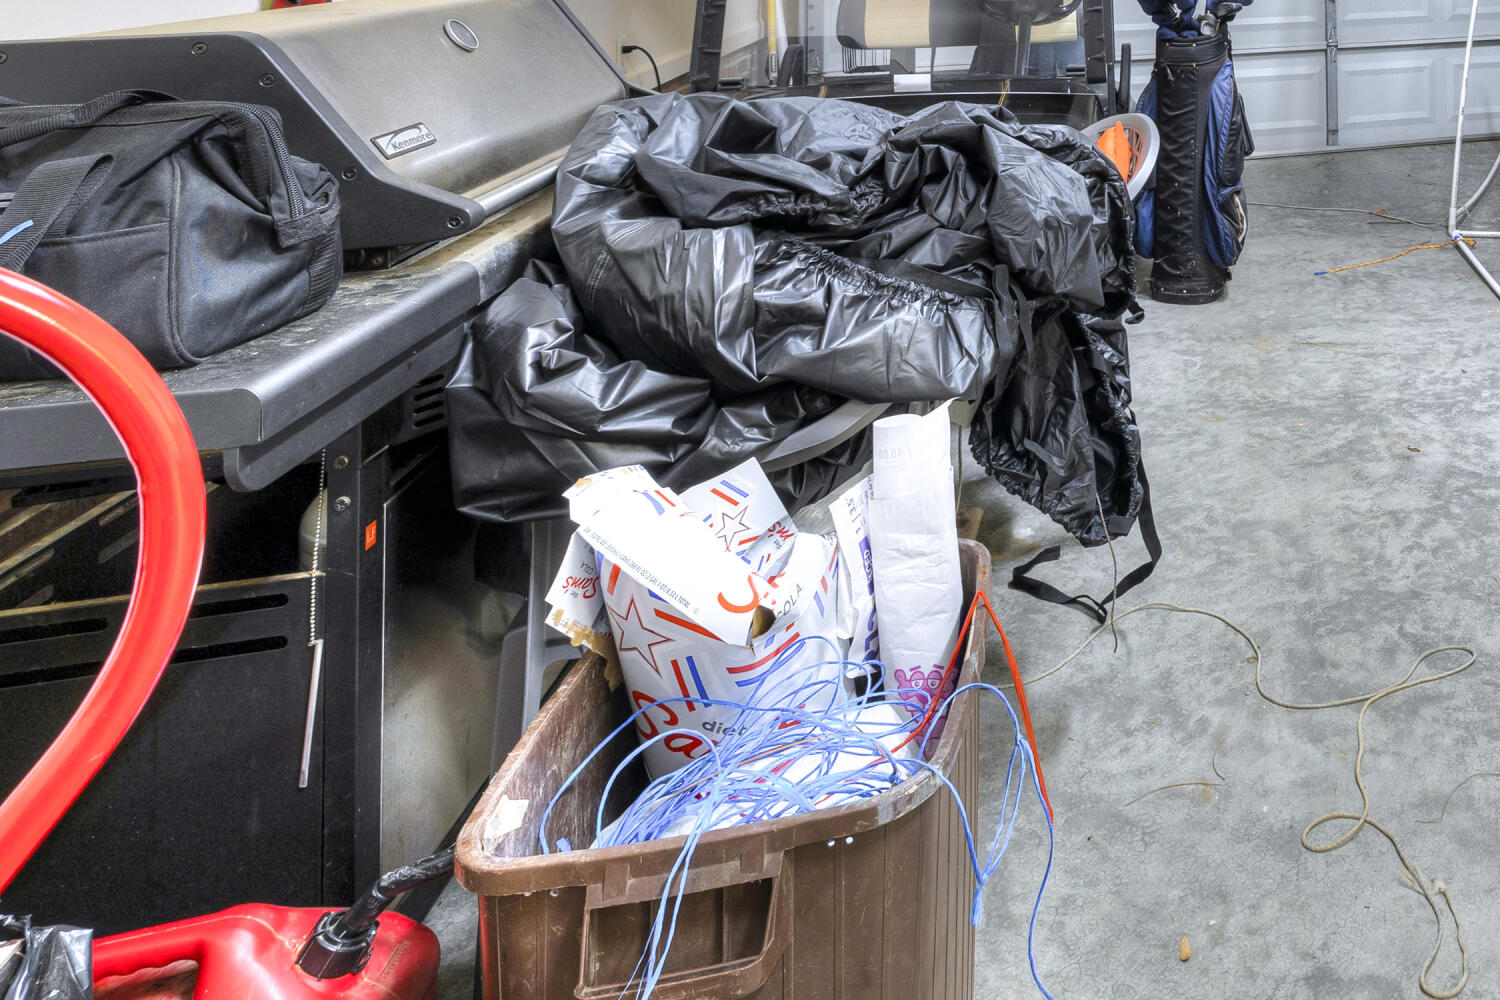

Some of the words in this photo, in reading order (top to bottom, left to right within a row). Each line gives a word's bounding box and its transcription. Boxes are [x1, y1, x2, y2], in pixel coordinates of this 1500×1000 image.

[391, 132, 432, 151] Kenmore
[581, 562, 594, 576] COLA
[562, 575, 600, 599] Sam's
[702, 720, 748, 737] diet
